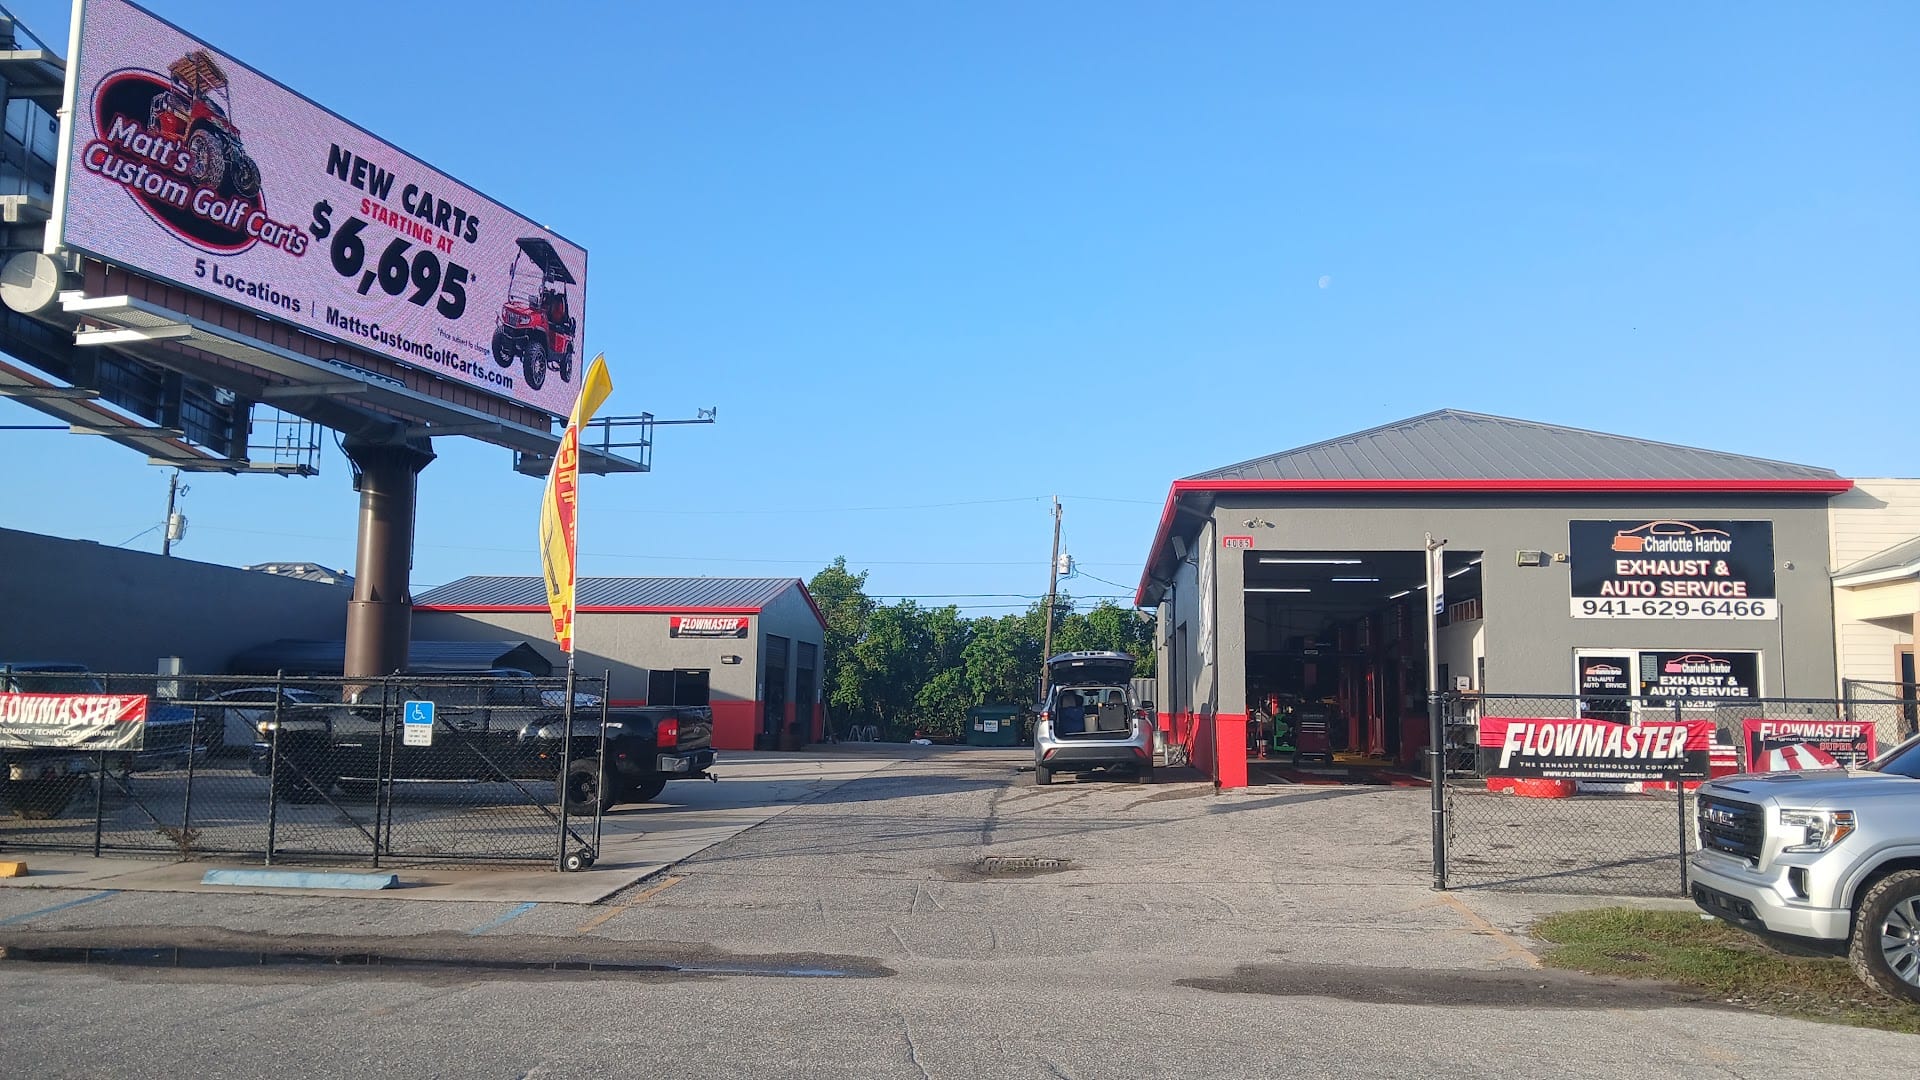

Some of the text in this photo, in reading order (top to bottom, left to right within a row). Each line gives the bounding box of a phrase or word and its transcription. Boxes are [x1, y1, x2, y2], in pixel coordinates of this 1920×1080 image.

[107, 116, 190, 173] Matt's
[84, 143, 307, 254] Custom Golf Carts
[326, 143, 480, 244] NEW CARTS
[360, 198, 454, 254] STARTING AT
[195, 257, 206, 279] 5
[212, 261, 301, 312] Locations
[326, 306, 514, 390] MattsCustomGolfCarts.com
[1644, 536, 1732, 552] Charlotte Harbor
[1616, 560, 1730, 576] EXHAUST &
[1601, 581, 1747, 597] AUTO SERVICE
[1582, 600, 1766, 617] 941-629-6466
[678, 618, 739, 634] FLOWMASTER
[1682, 663, 1731, 673] Charlotte Harbor
[1660, 676, 1738, 686] EXHAUST &
[1650, 686, 1749, 696] AUTO SERVICE
[1760, 722, 1861, 741] FLOWMASTER
[1498, 722, 1688, 769] FLOWMASTER
[1542, 771, 1663, 779] WWW.FLOWMASTERMUFFLERS.COM
